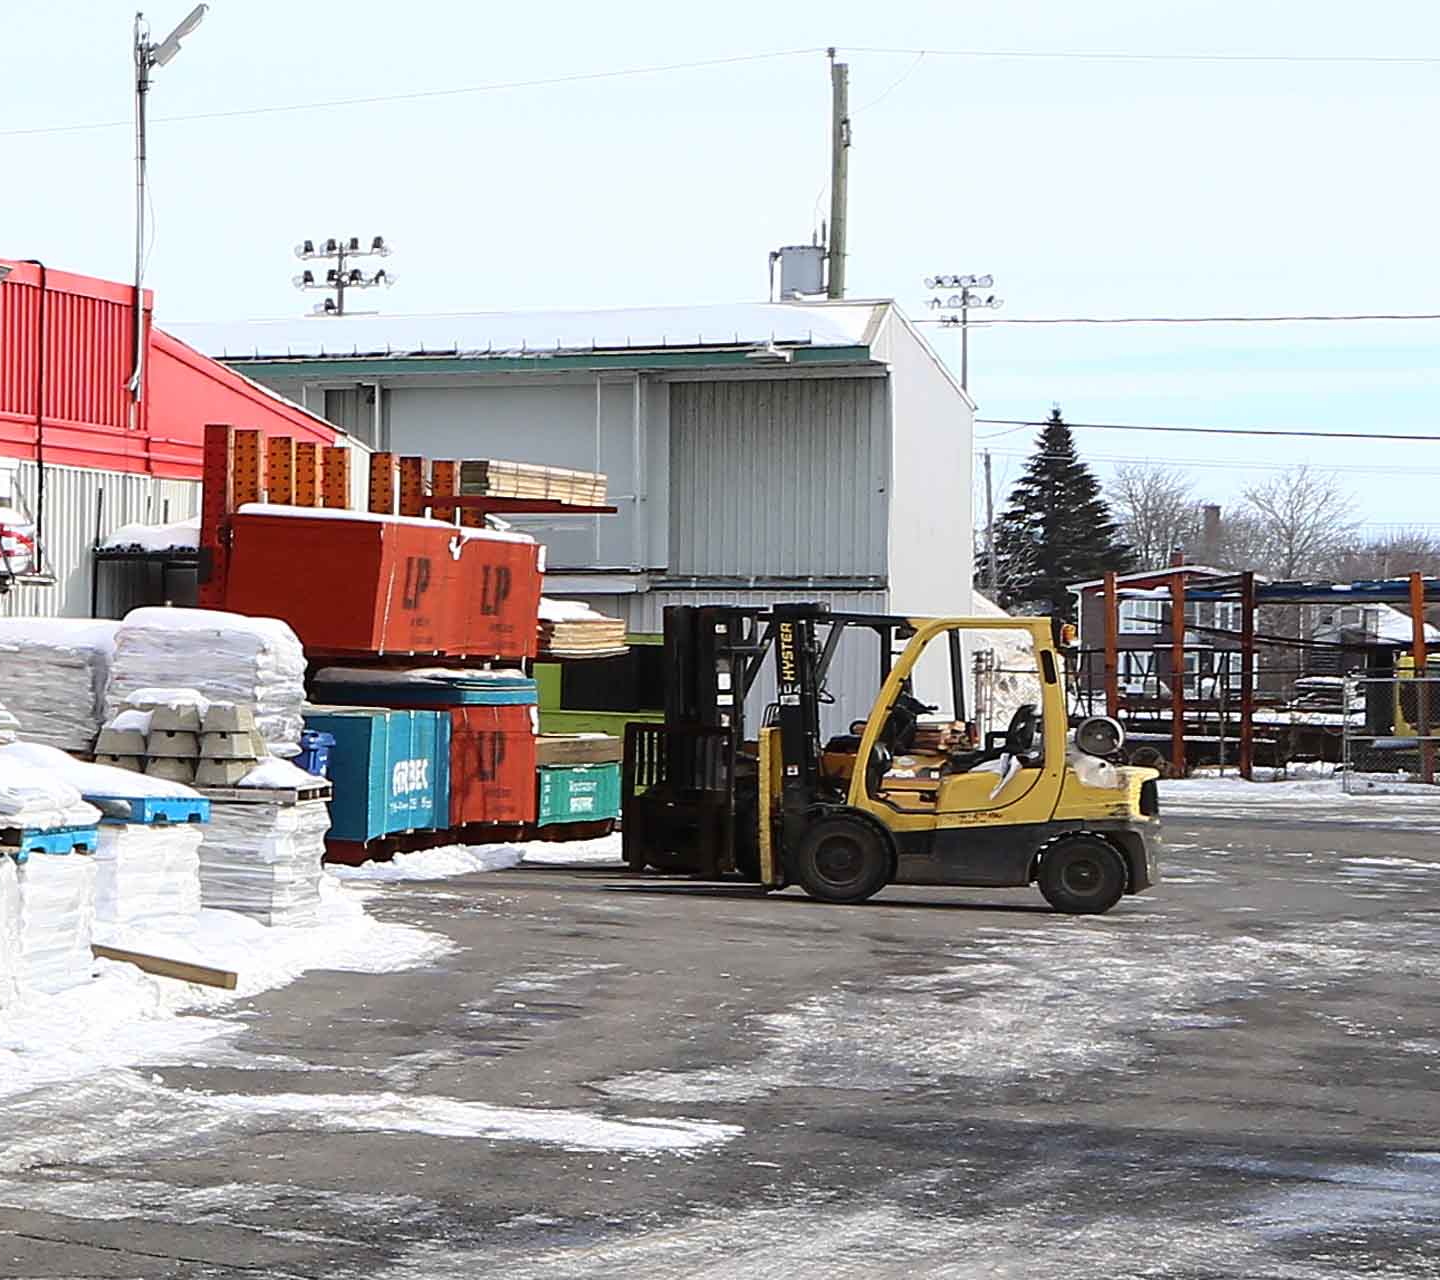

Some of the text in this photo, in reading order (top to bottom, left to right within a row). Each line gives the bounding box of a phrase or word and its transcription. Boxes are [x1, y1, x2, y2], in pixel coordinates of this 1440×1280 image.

[402, 557, 430, 609] LP
[481, 565, 511, 616] LP
[780, 623, 795, 681] HYSTER
